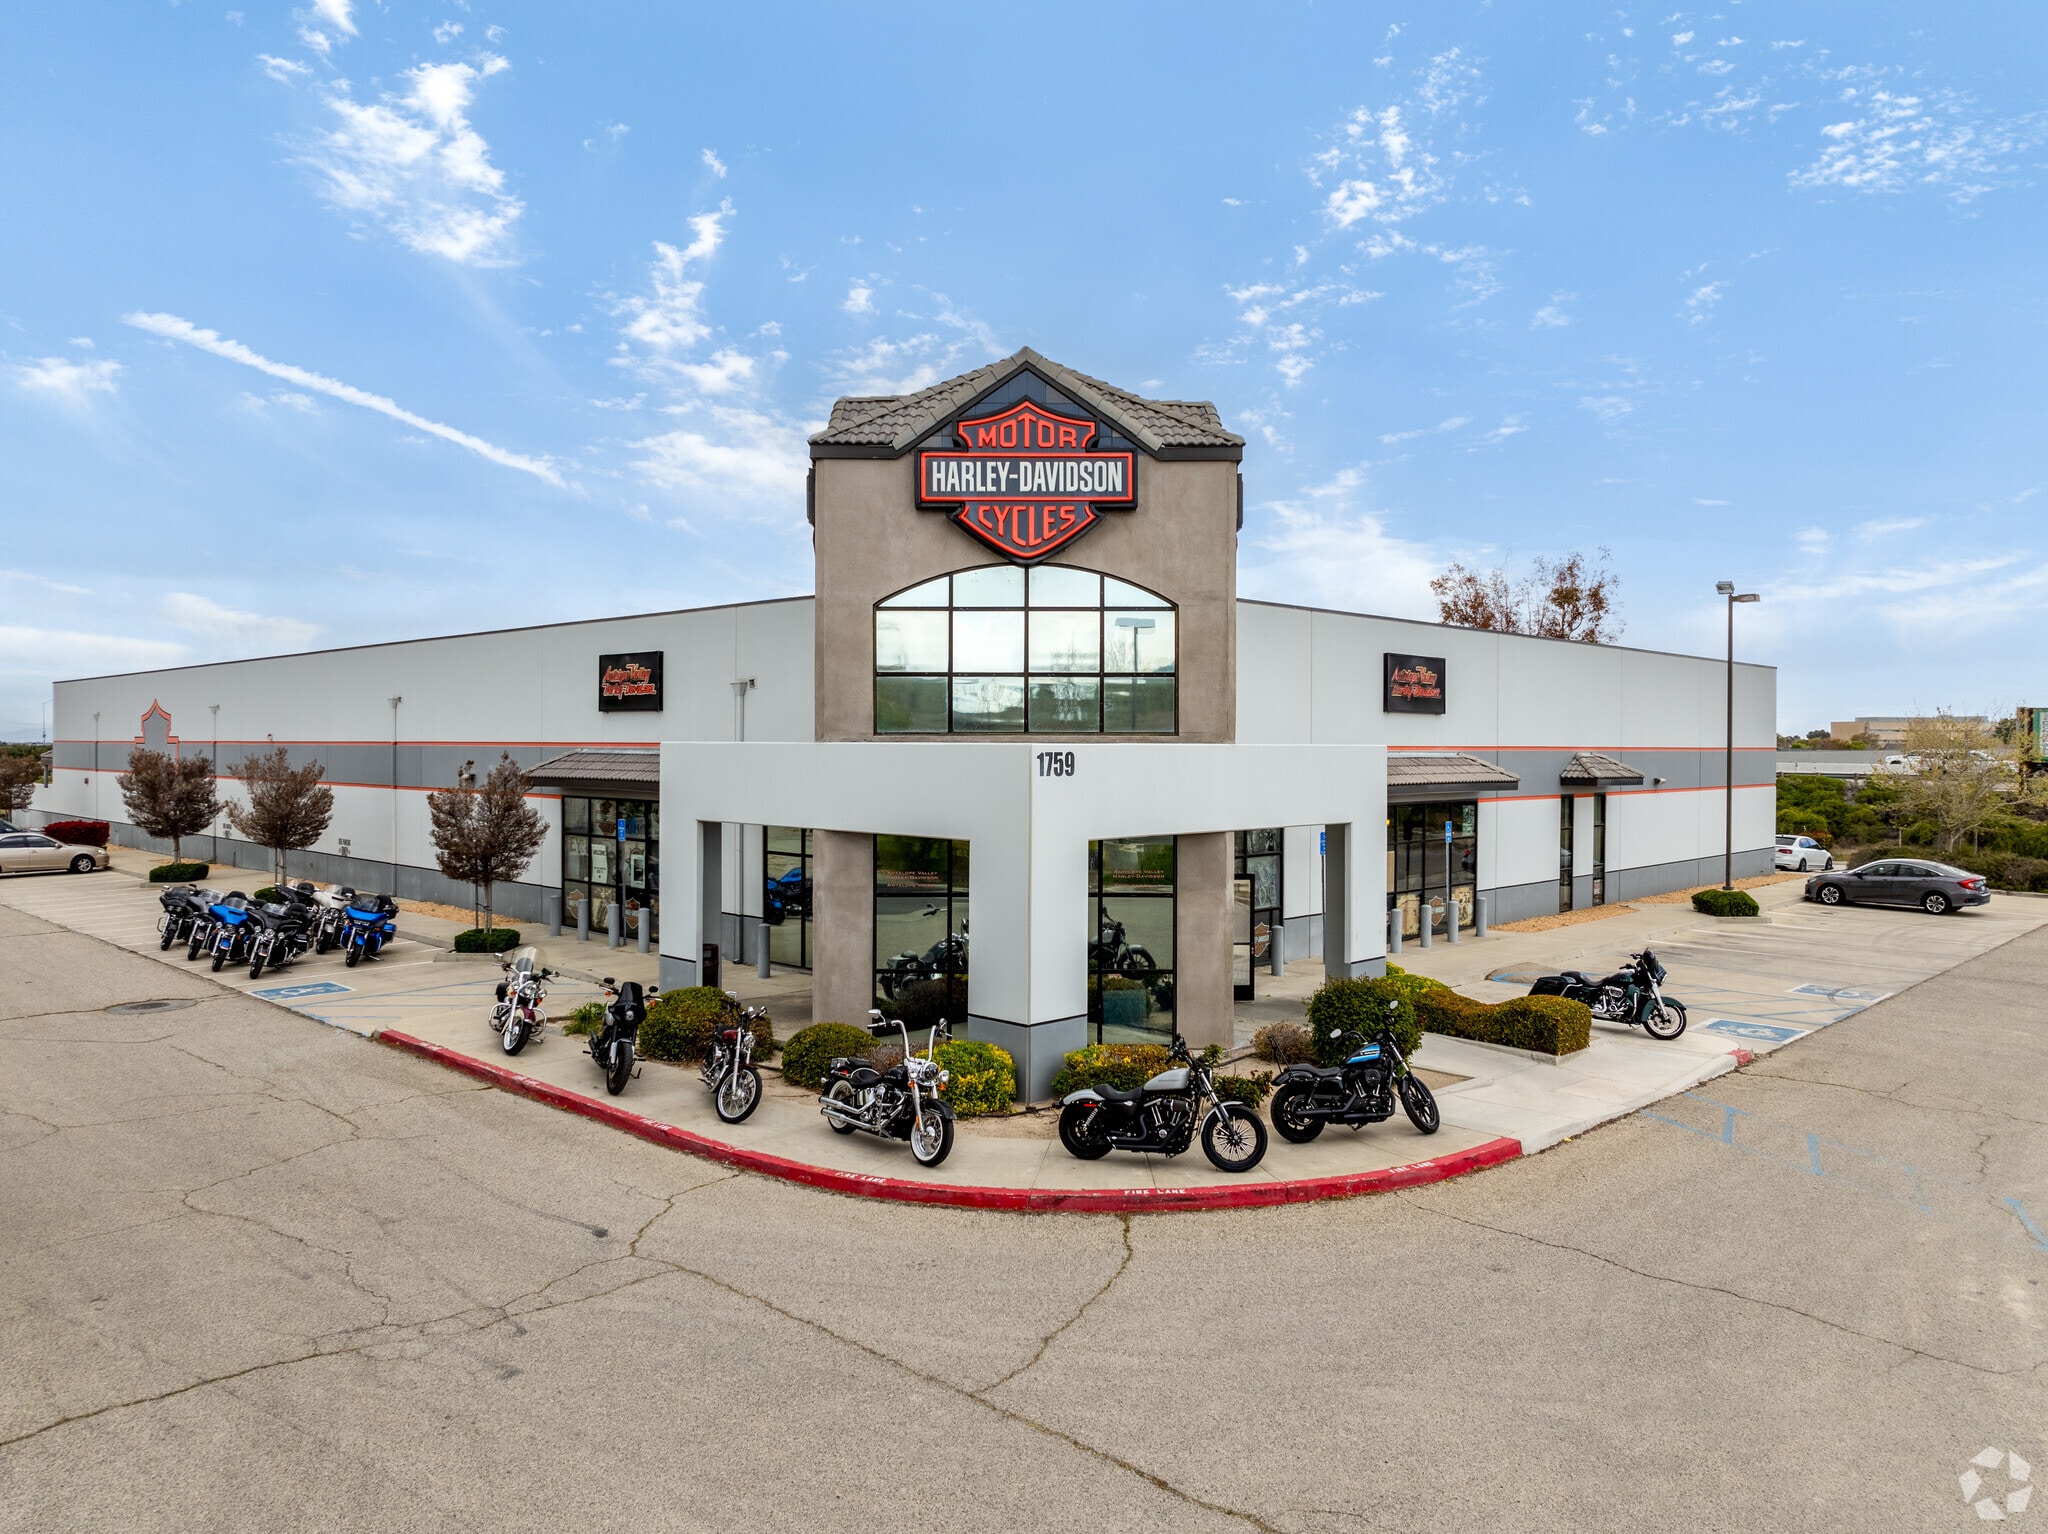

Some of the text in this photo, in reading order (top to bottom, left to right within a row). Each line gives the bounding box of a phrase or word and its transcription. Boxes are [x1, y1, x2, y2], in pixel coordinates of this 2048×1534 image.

[977, 412, 1077, 448] MOTOR
[932, 461, 1123, 492] HARLEY-DAVIDSON
[977, 505, 1076, 547] CYCLES
[1037, 751, 1075, 777] 1759
